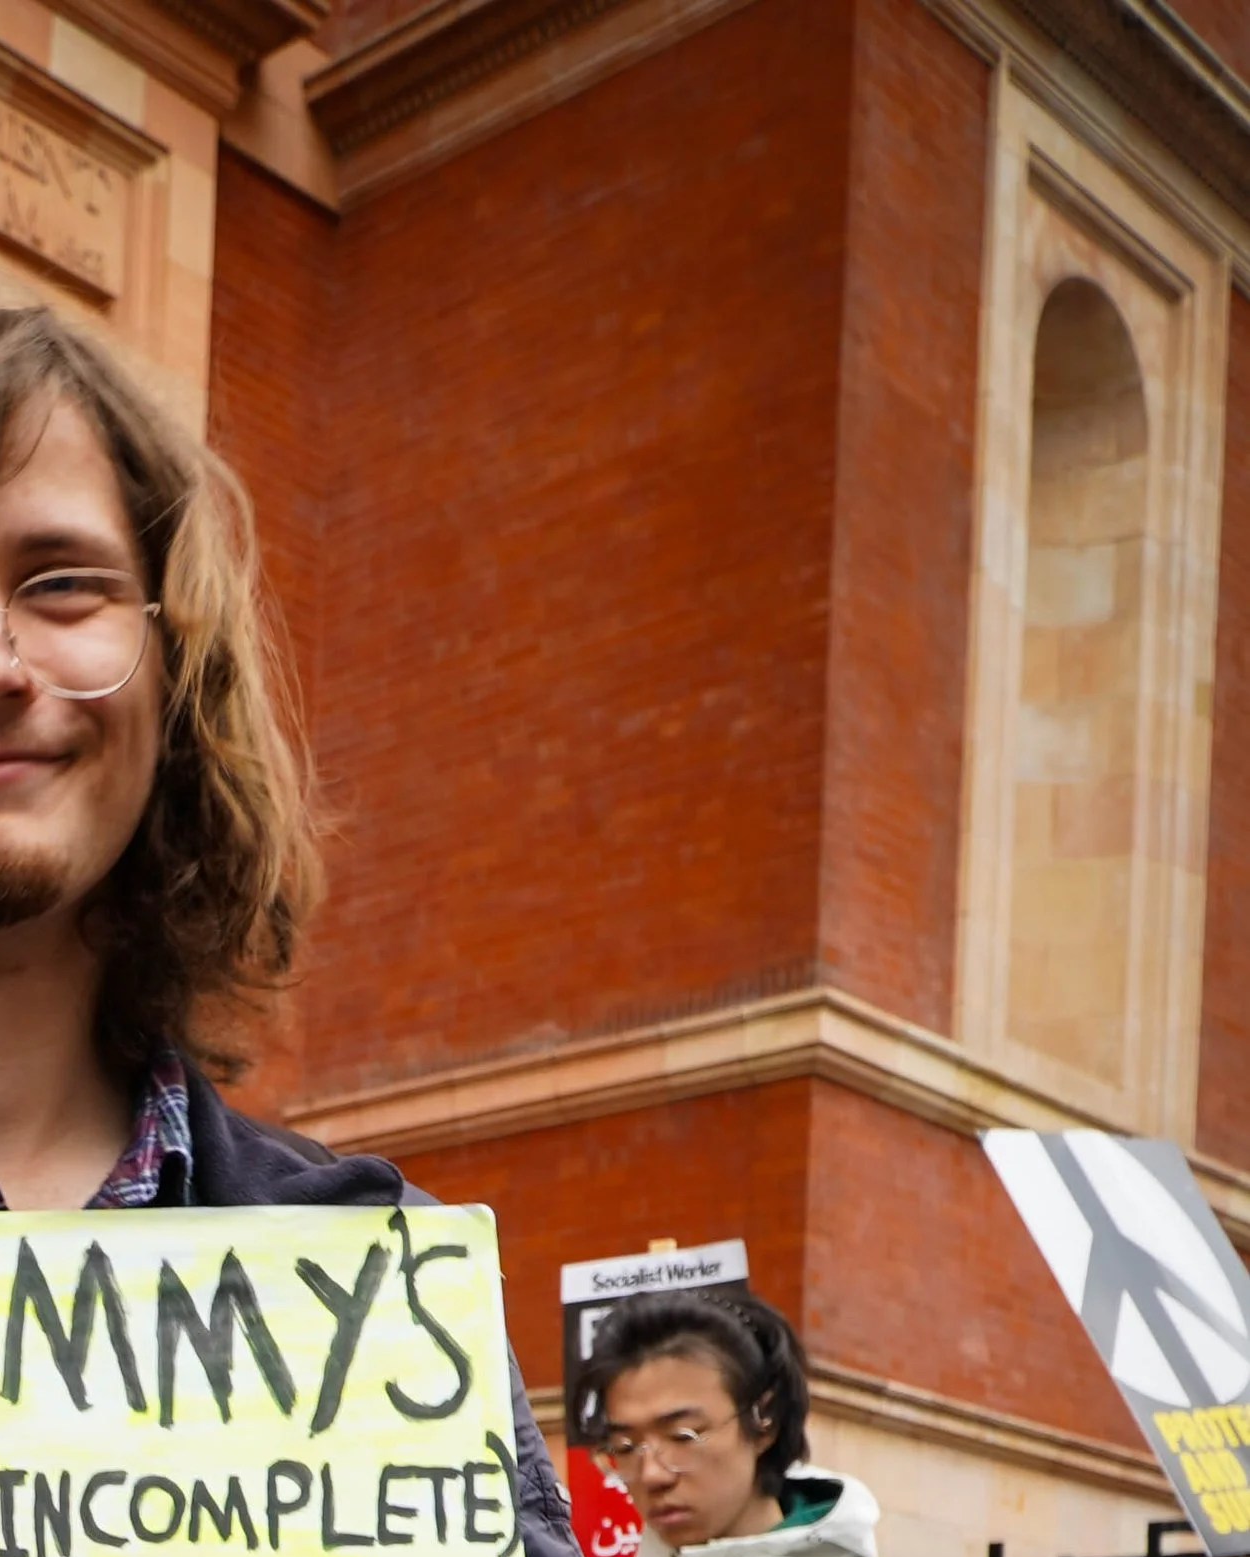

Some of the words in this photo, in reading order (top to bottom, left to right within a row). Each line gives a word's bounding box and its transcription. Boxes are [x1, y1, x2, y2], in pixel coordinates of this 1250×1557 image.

[592, 1266, 663, 1292] Socialist
[665, 1259, 720, 1282] Worker
[1153, 1404, 1250, 1454] PROTE
